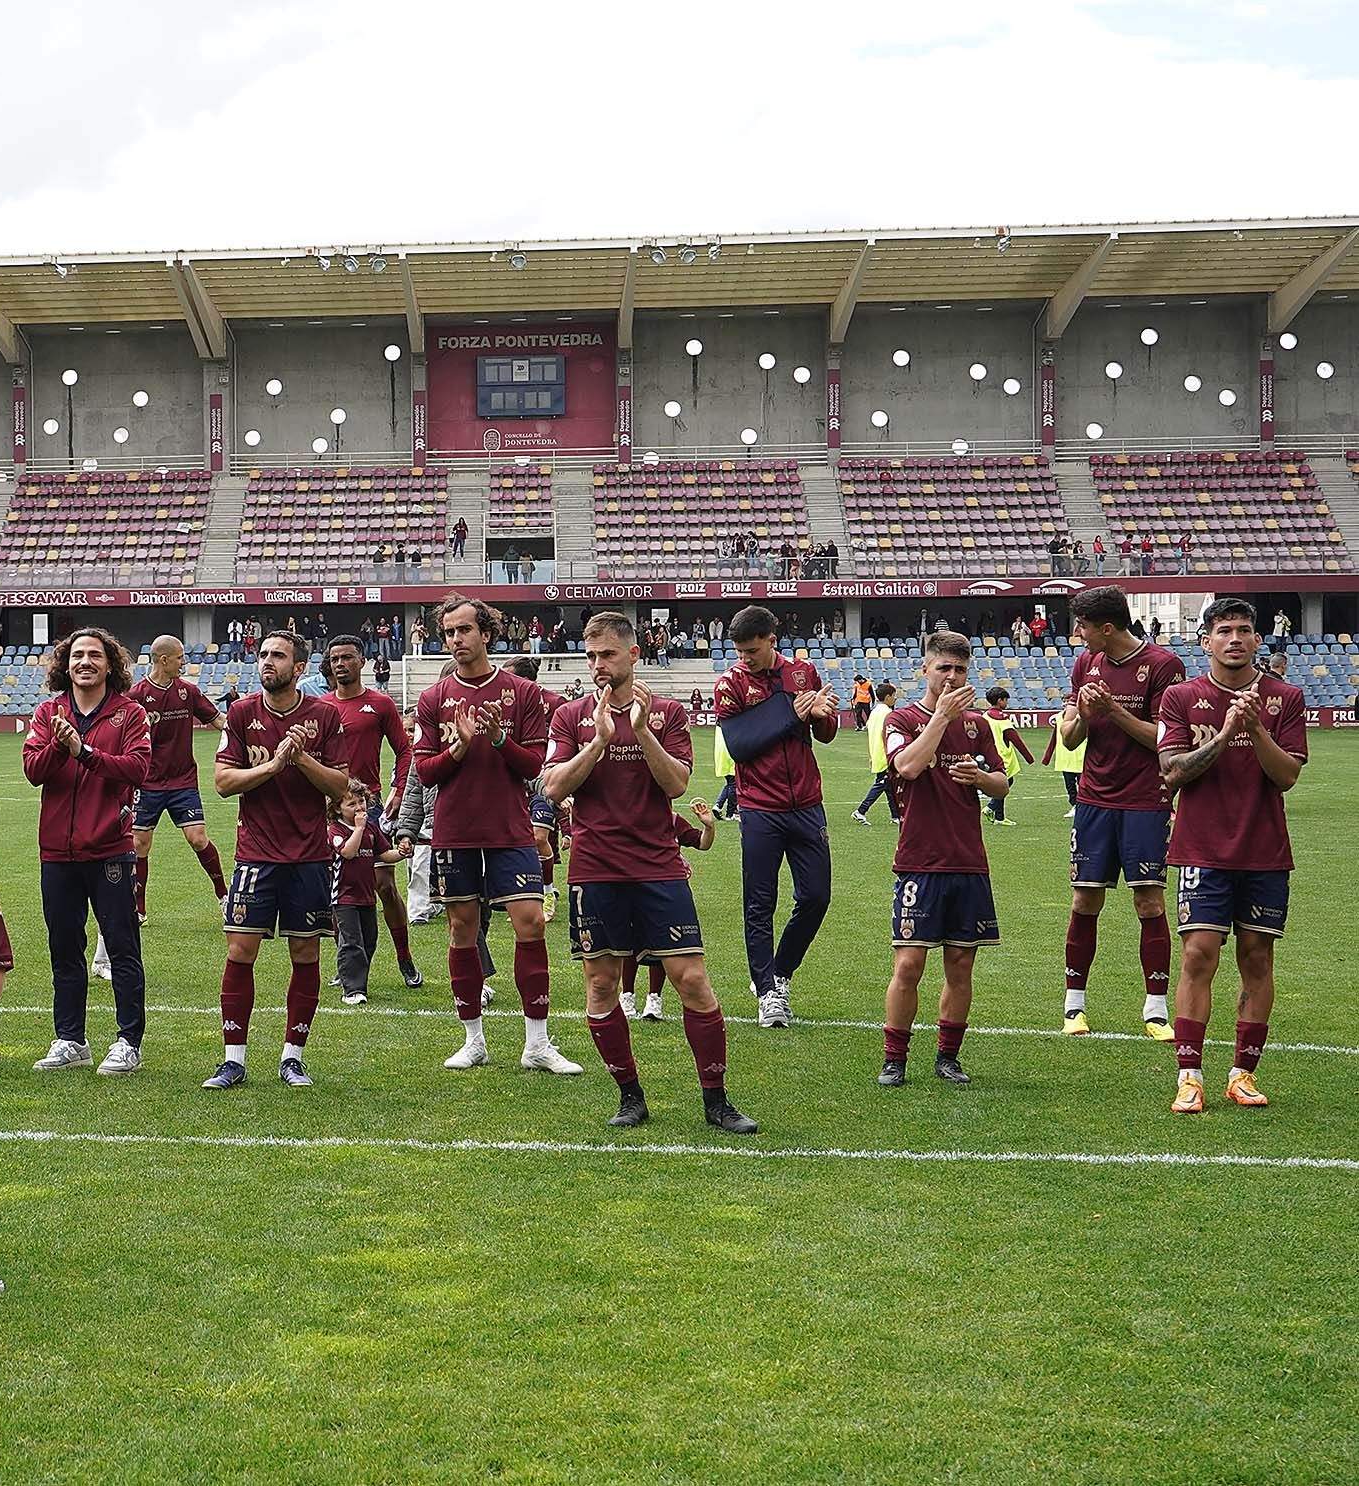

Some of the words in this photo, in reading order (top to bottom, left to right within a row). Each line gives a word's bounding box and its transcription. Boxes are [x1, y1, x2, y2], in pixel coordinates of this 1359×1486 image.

[438, 336, 491, 349] FORZA
[495, 333, 603, 348] PONTEVEDRA
[505, 438, 558, 447] PONTEVEDRA
[565, 586, 653, 598] CELTAMOTOR
[675, 583, 706, 593] FROIZ
[721, 583, 752, 593] FROIZ
[766, 582, 797, 593] FROIZ
[822, 582, 871, 596] Estrella
[874, 581, 920, 595] Galicia
[238, 866, 260, 893] 11
[1179, 866, 1200, 891] 19
[572, 886, 583, 915] 7
[902, 881, 918, 907] 8
